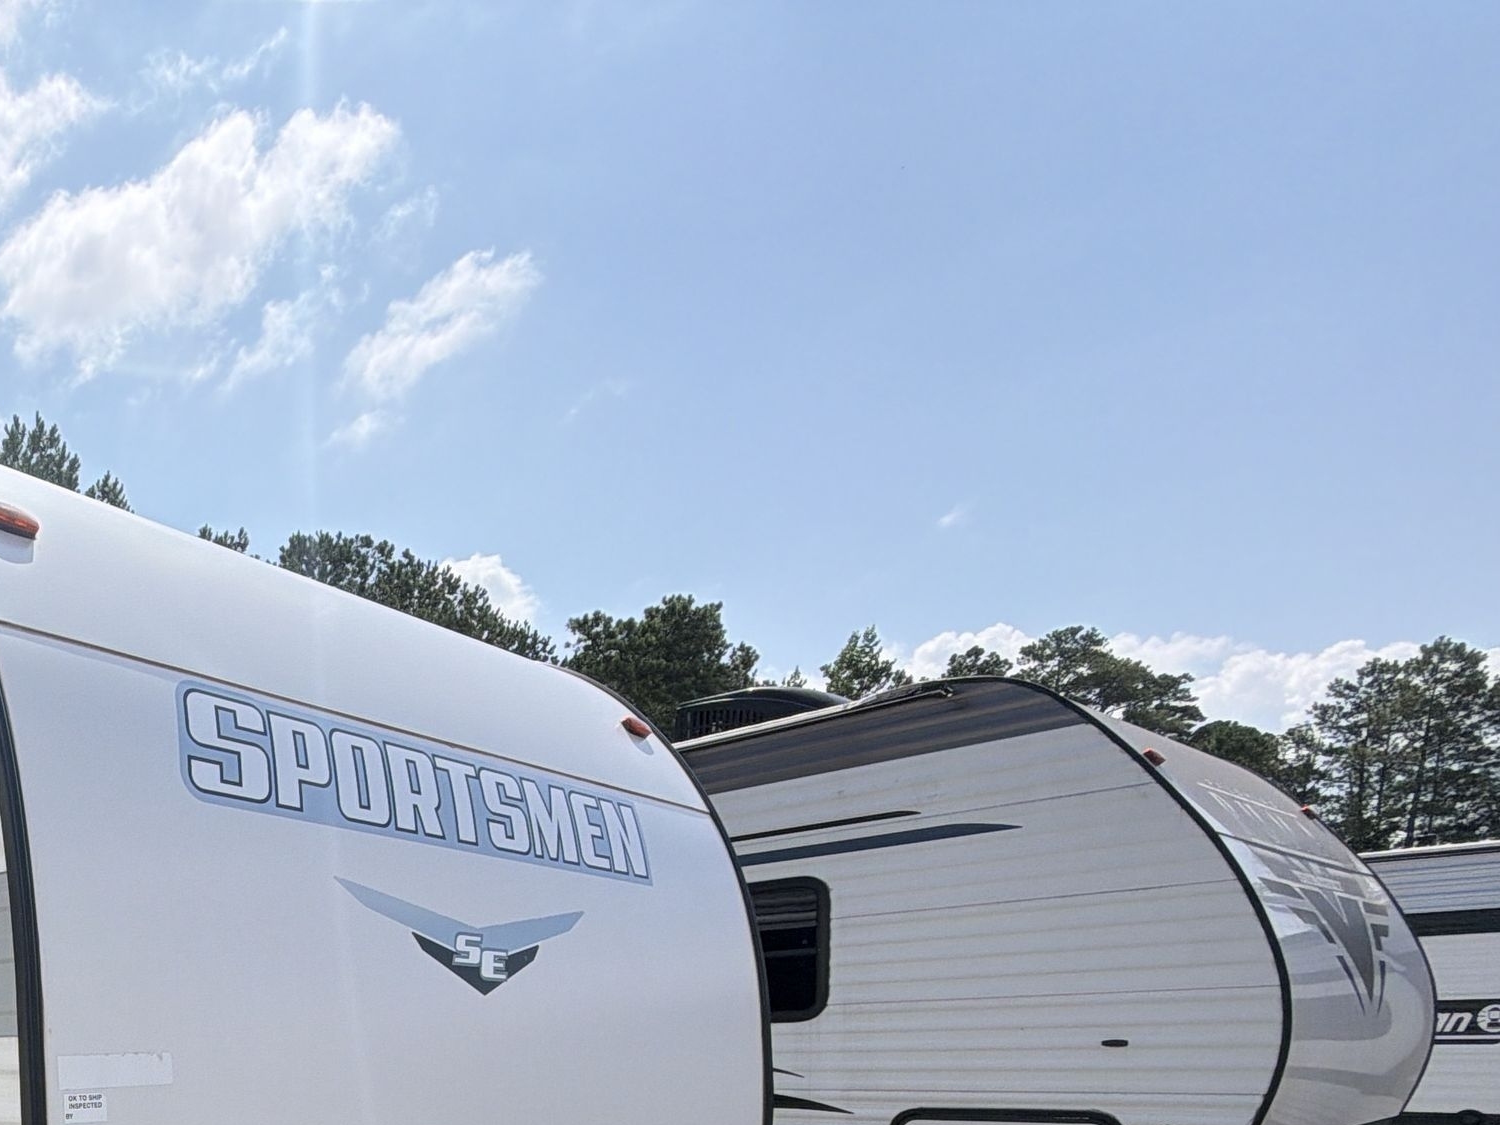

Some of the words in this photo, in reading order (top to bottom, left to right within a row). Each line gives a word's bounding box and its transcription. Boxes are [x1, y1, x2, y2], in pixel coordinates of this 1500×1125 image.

[183, 688, 651, 879] SPORTSMEN
[452, 933, 509, 982] SE
[68, 1102, 102, 1110] INSPECTED
